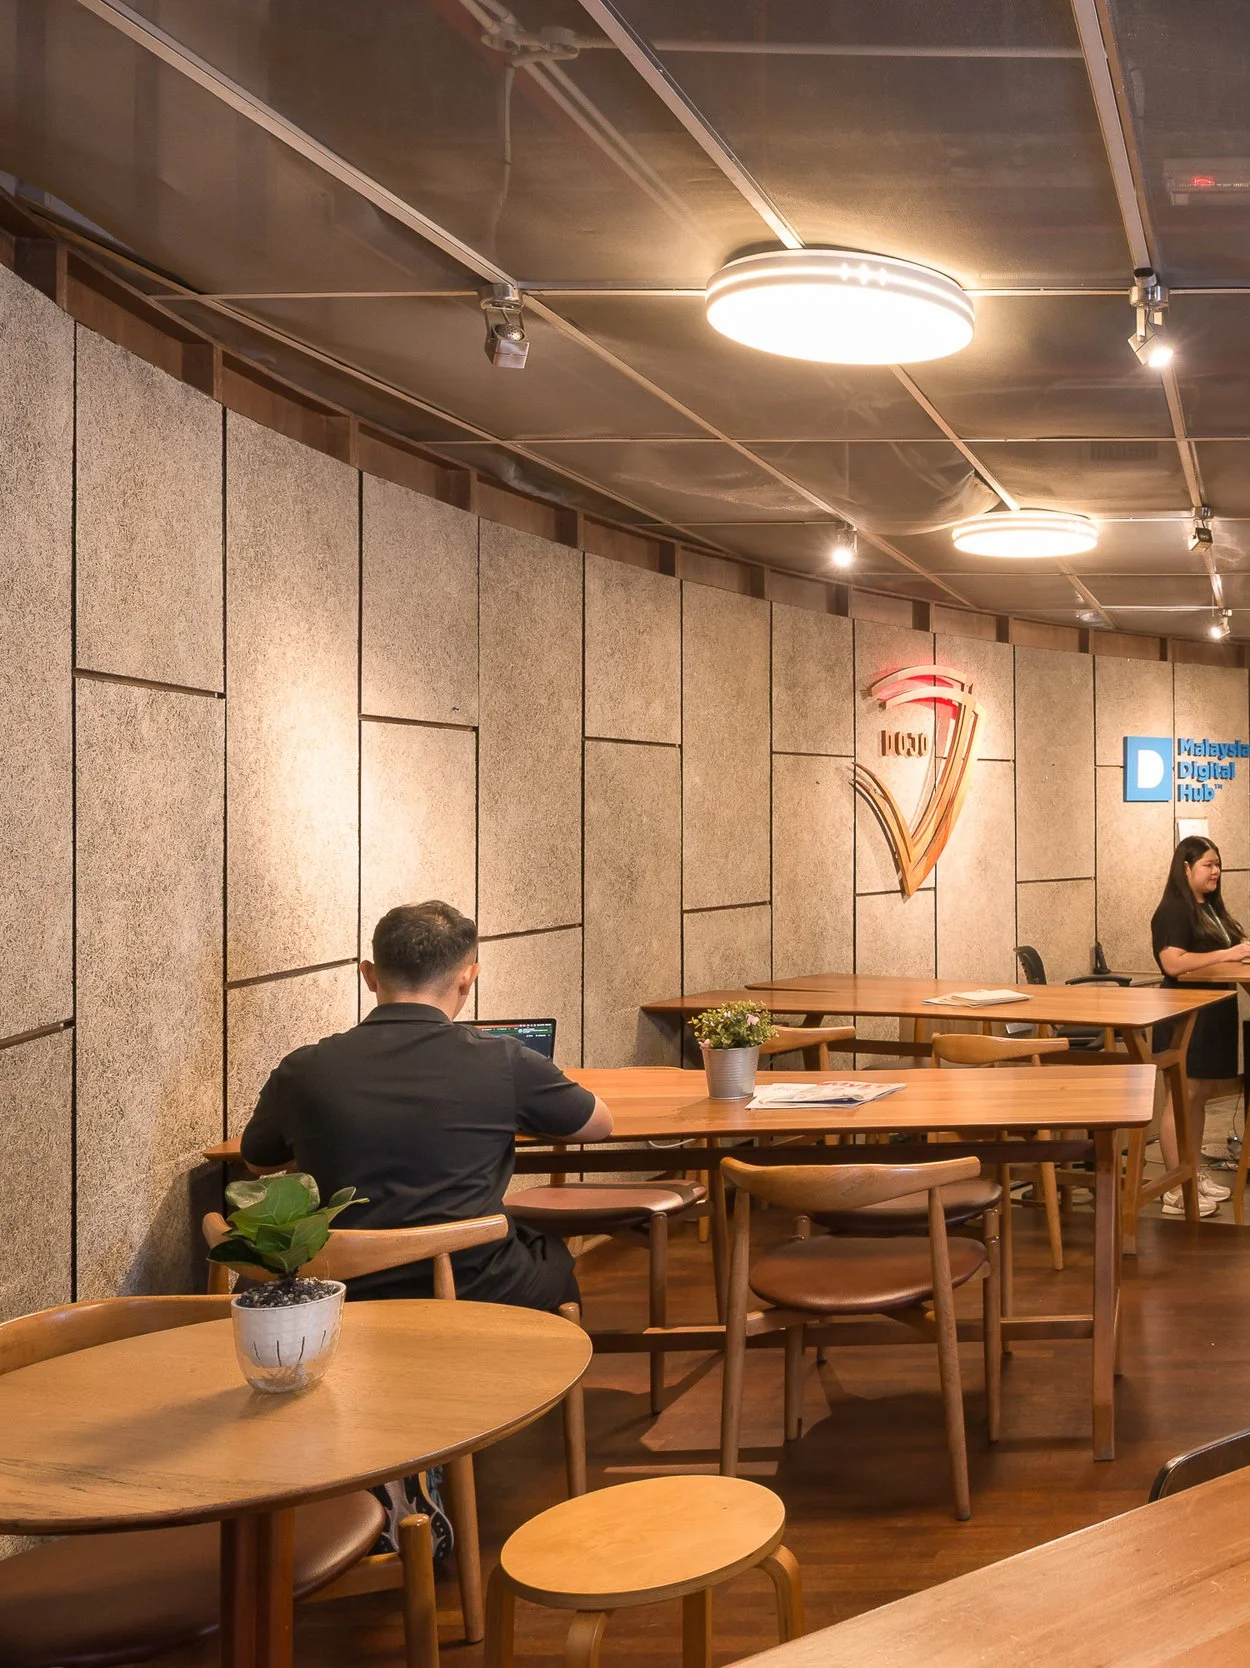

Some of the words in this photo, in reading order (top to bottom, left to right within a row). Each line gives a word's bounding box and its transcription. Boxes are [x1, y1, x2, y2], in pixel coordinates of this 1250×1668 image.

[882, 730, 929, 757] DOJO
[1178, 738, 1250, 760] Malaysia
[1137, 749, 1164, 789] D
[1178, 761, 1236, 783] Digital
